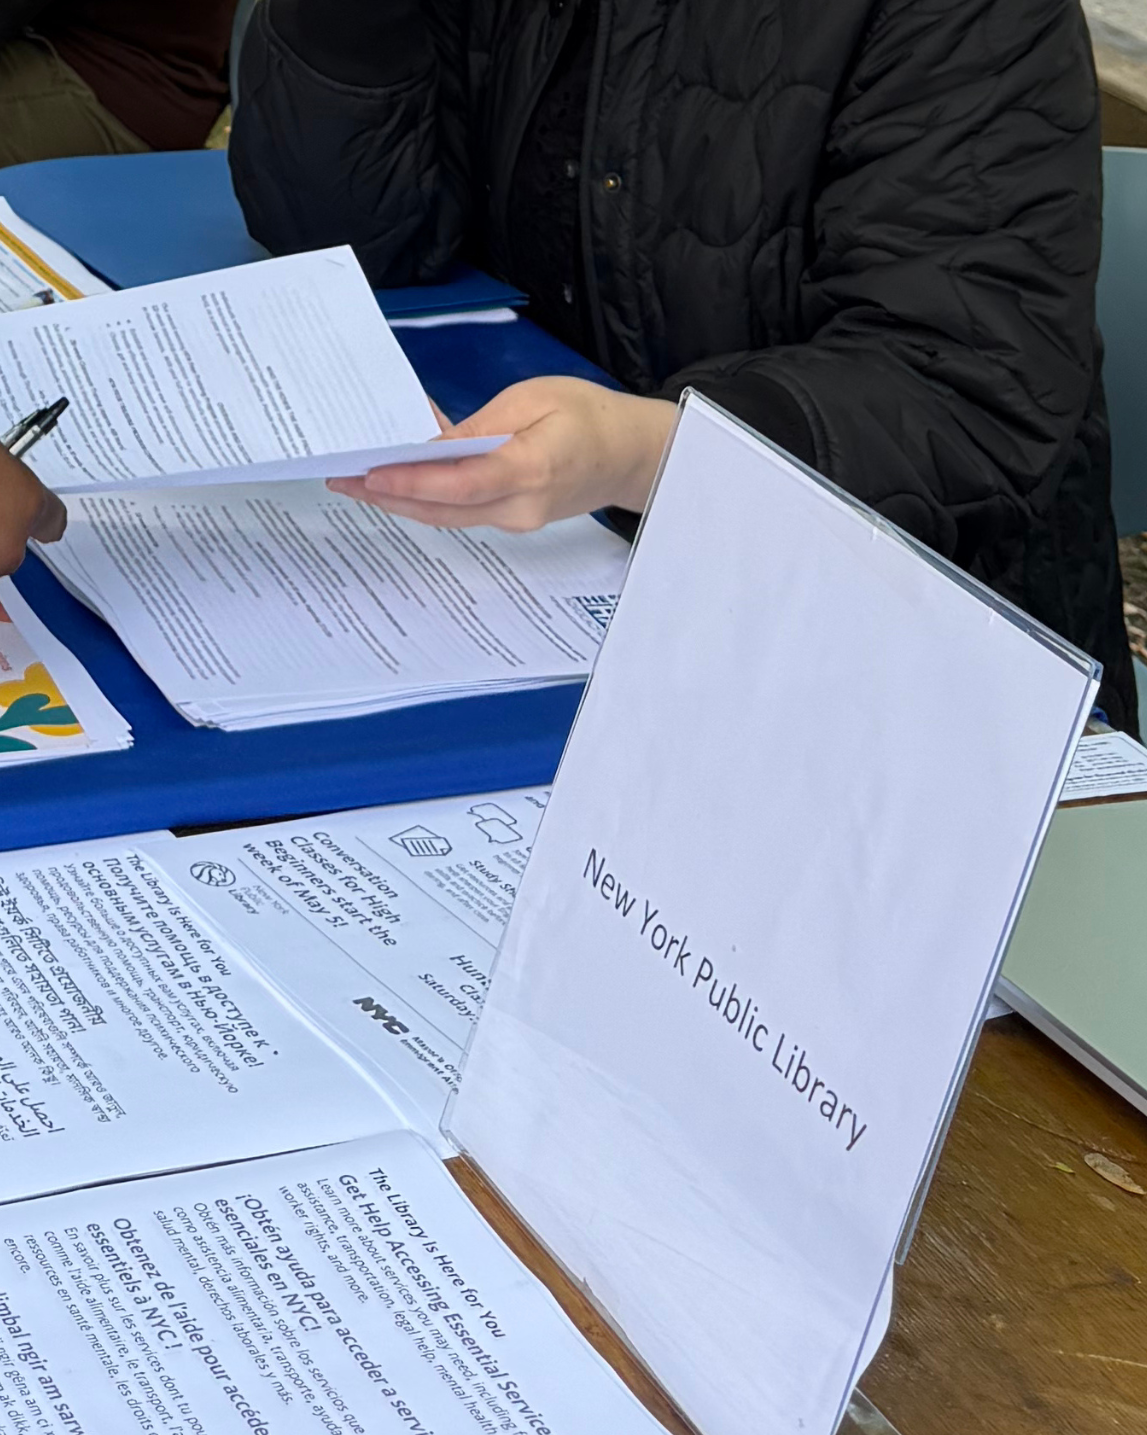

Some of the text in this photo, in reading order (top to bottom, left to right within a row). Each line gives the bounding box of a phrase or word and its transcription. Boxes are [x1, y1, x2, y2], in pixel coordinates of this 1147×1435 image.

[125, 853, 232, 977] The Library Is Here for You
[242, 842, 350, 929] week of May 5!
[264, 839, 398, 947] Beginners start the
[289, 835, 401, 925] Classes for High
[312, 831, 399, 900] Conversation
[81, 860, 264, 1068] основным услугам в Нью-Йорке!
[102, 857, 270, 1049] Получите помощь в доступе к
[352, 996, 410, 1036] NYC
[582, 846, 868, 1153] New York Public Library
[0, 1072, 31, 1095] على
[19, 1096, 66, 1134] احصل
[85, 1222, 143, 1294] essentiels
[132, 1295, 153, 1306] à
[214, 1198, 323, 1332] esenciales en NYC!
[278, 1185, 369, 1304] worker rights, and more.
[296, 1182, 340, 1235] assistance,
[335, 1234, 396, 1310] transportation,
[392, 1309, 422, 1336] legal
[412, 1336, 437, 1364] help,
[432, 1363, 473, 1401] mental
[315, 1177, 518, 1432] Learn more about services you may need, including
[338, 1173, 552, 1435] Get Help Accessing Essential Service
[368, 1167, 506, 1339] The Library Is Here for You
[63, 1226, 193, 1416] En savoir plus sur les services dont tu
[113, 1217, 162, 1280] Obtenez
[153, 1281, 176, 1301] de
[190, 1344, 232, 1382] pour
[222, 1384, 270, 1435] accéde
[192, 1201, 371, 1435] Obtén más información sobre los servicios que
[234, 1193, 435, 1435] ¡Obtén ayuda para acceder a servi
[16, 1341, 49, 1372] ngir
[37, 1375, 63, 1401] am
[53, 1402, 85, 1435] sarw
